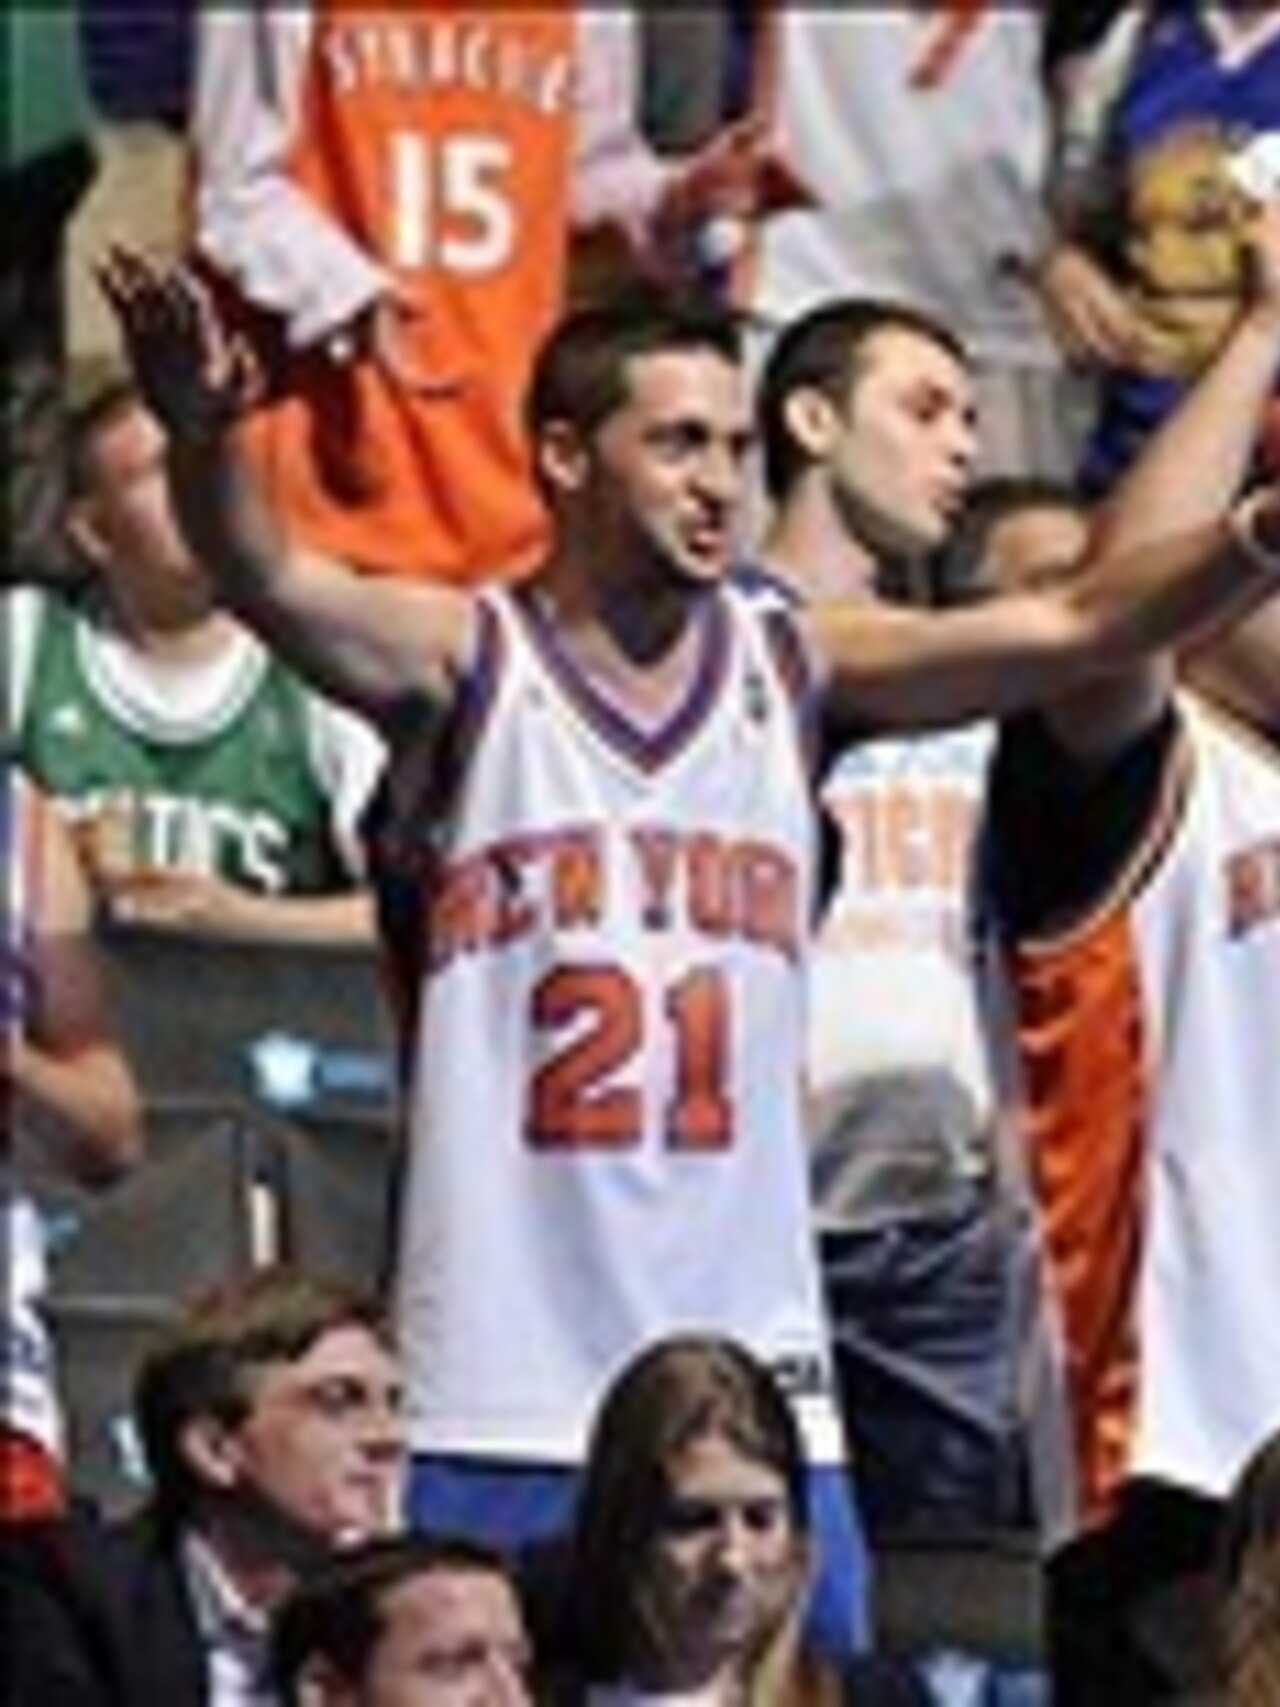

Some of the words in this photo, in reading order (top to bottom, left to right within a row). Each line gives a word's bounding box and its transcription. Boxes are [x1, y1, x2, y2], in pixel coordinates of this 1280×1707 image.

[388, 131, 516, 273] 15
[428, 822, 599, 976] NEW
[522, 962, 733, 1154] 21
